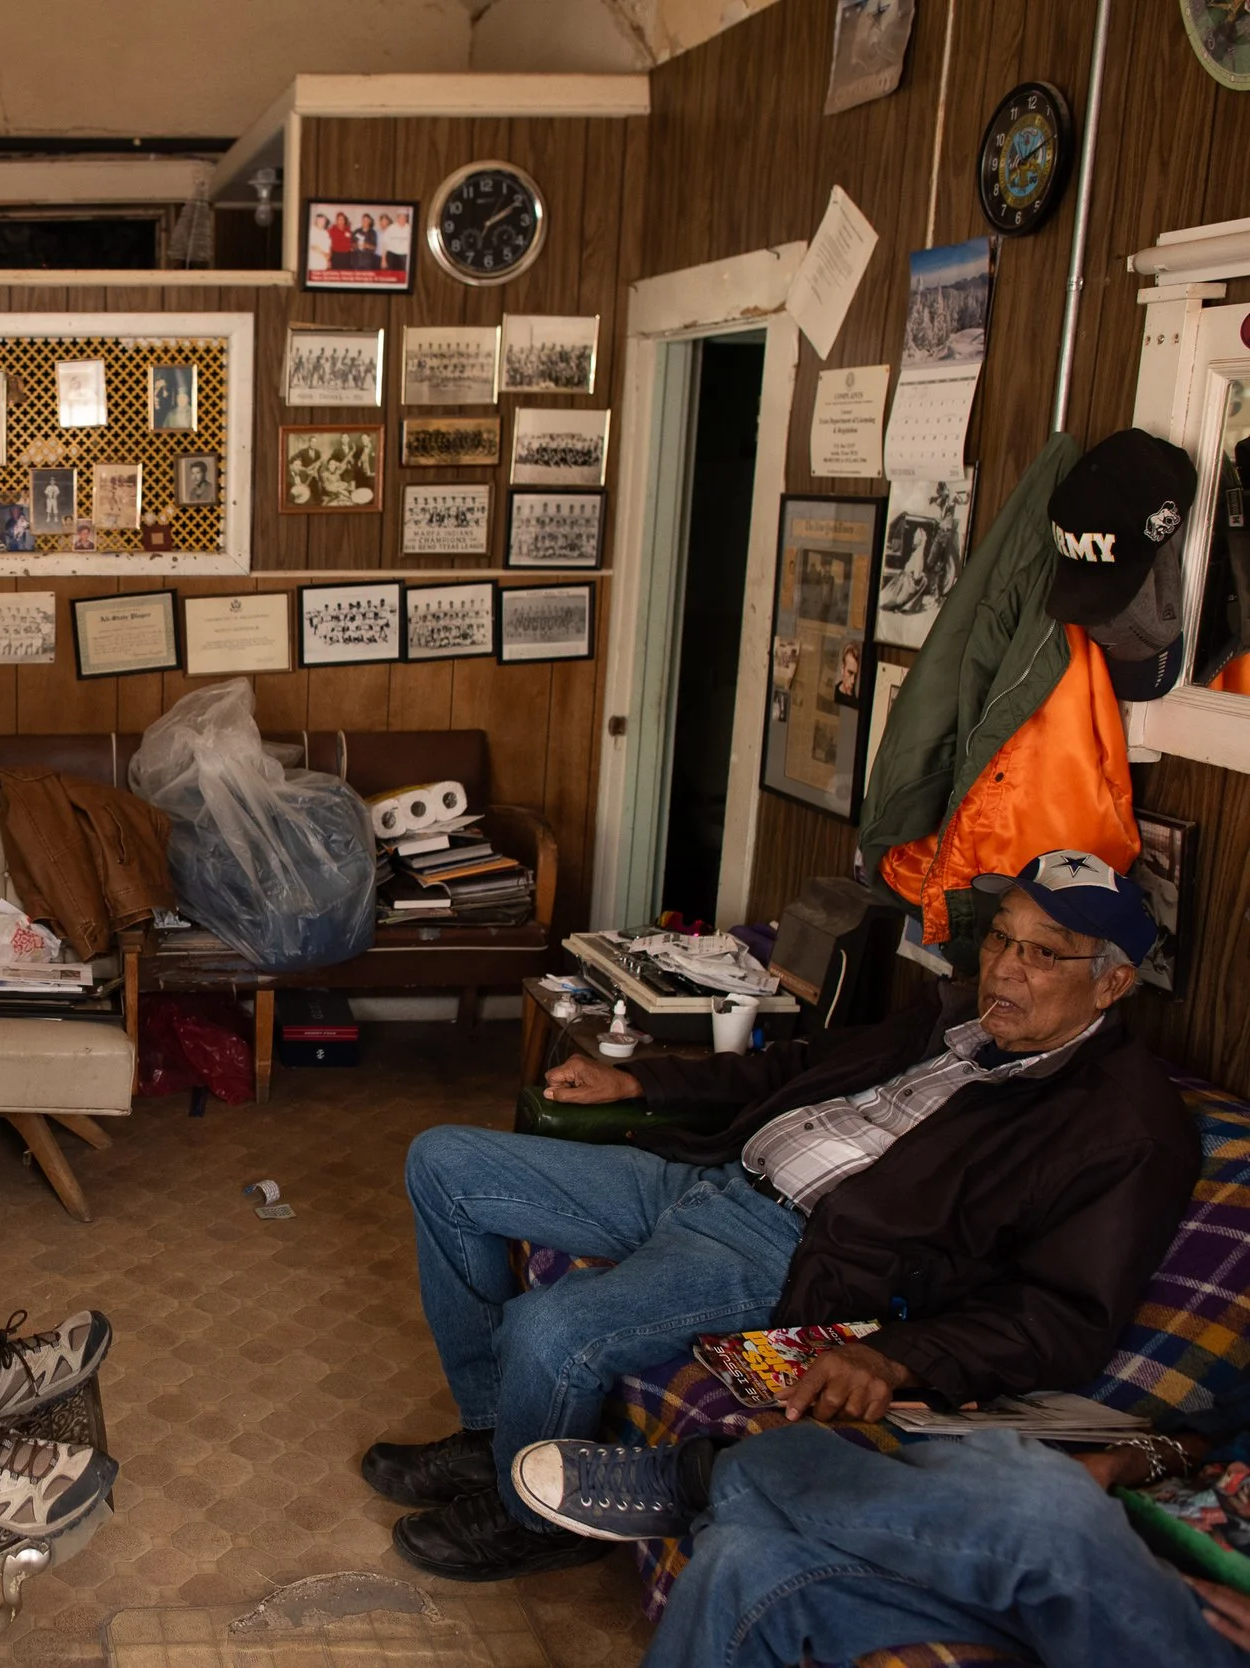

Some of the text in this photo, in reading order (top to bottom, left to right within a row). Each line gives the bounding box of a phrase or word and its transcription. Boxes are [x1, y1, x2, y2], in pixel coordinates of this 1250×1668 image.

[463, 185, 474, 199] 11
[479, 180, 493, 192] 12
[714, 1346, 749, 1385] ISSUE
